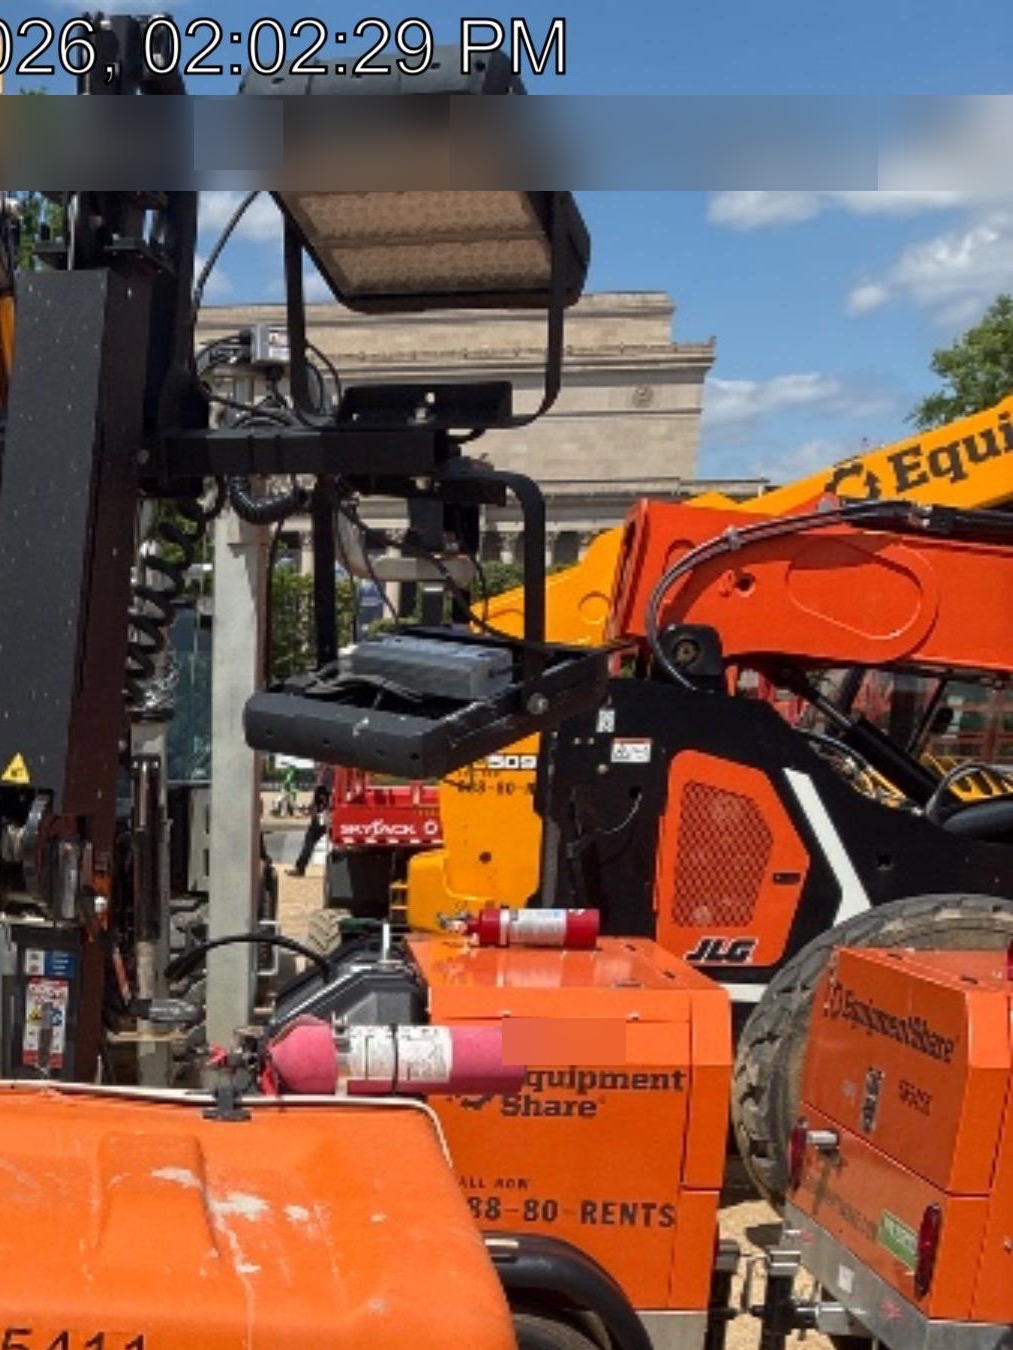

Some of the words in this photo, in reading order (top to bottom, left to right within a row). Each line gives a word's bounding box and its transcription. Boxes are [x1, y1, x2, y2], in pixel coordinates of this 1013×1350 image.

[340, 818, 417, 838] SKYJACK
[684, 936, 759, 963] JLG
[523, 1065, 687, 1094] quipment
[501, 1095, 598, 1118] Share
[459, 1176, 486, 1189] ALL
[467, 1196, 676, 1228] 88-80-RENTS
